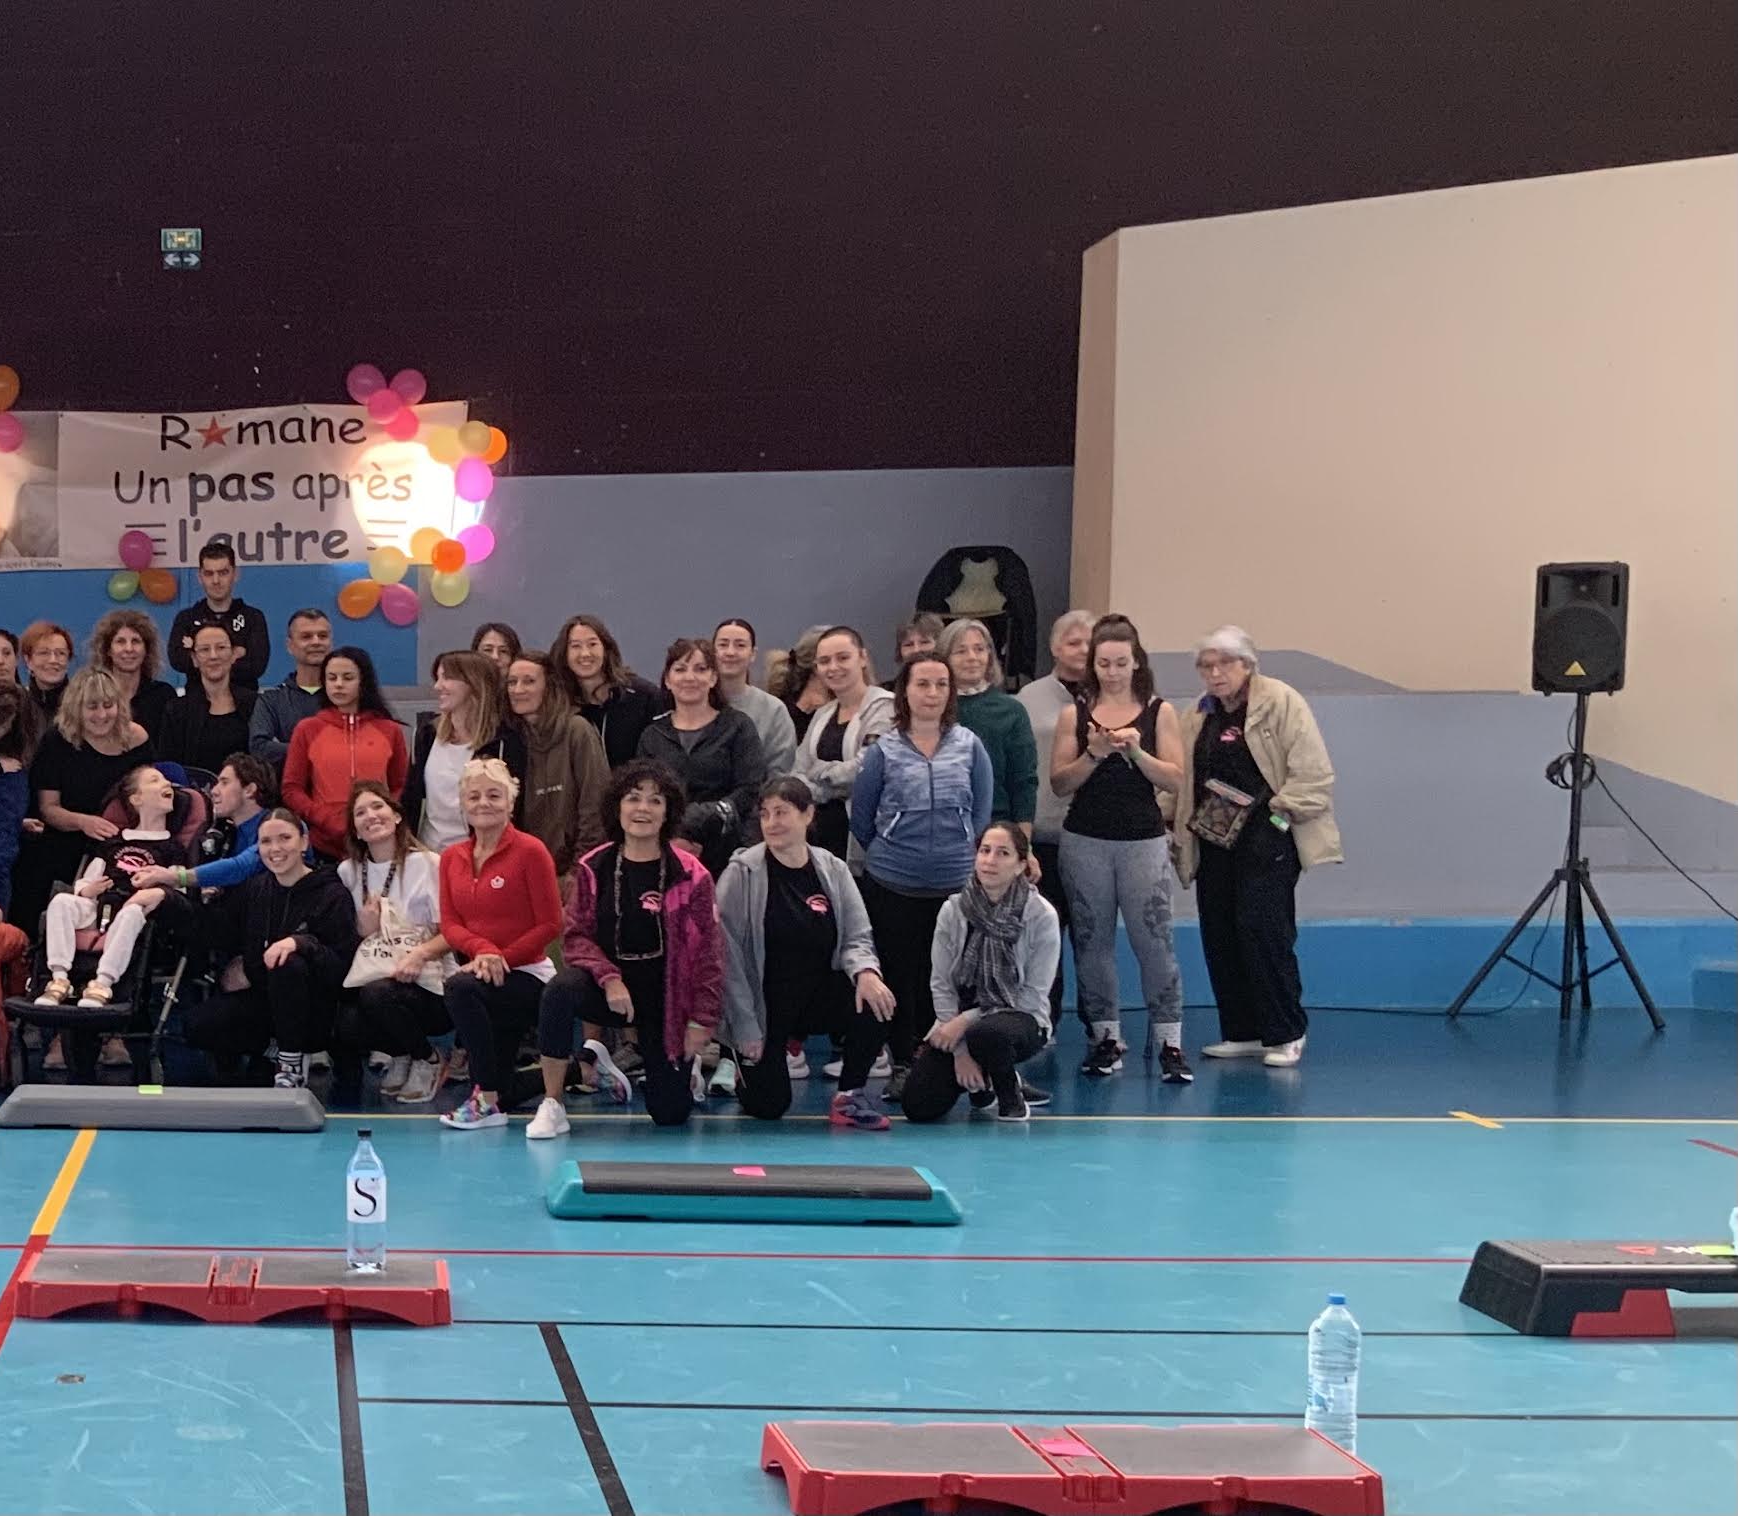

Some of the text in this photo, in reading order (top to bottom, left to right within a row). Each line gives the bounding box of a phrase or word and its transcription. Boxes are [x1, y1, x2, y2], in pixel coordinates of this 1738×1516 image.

[114, 462, 412, 517] Un pas après
